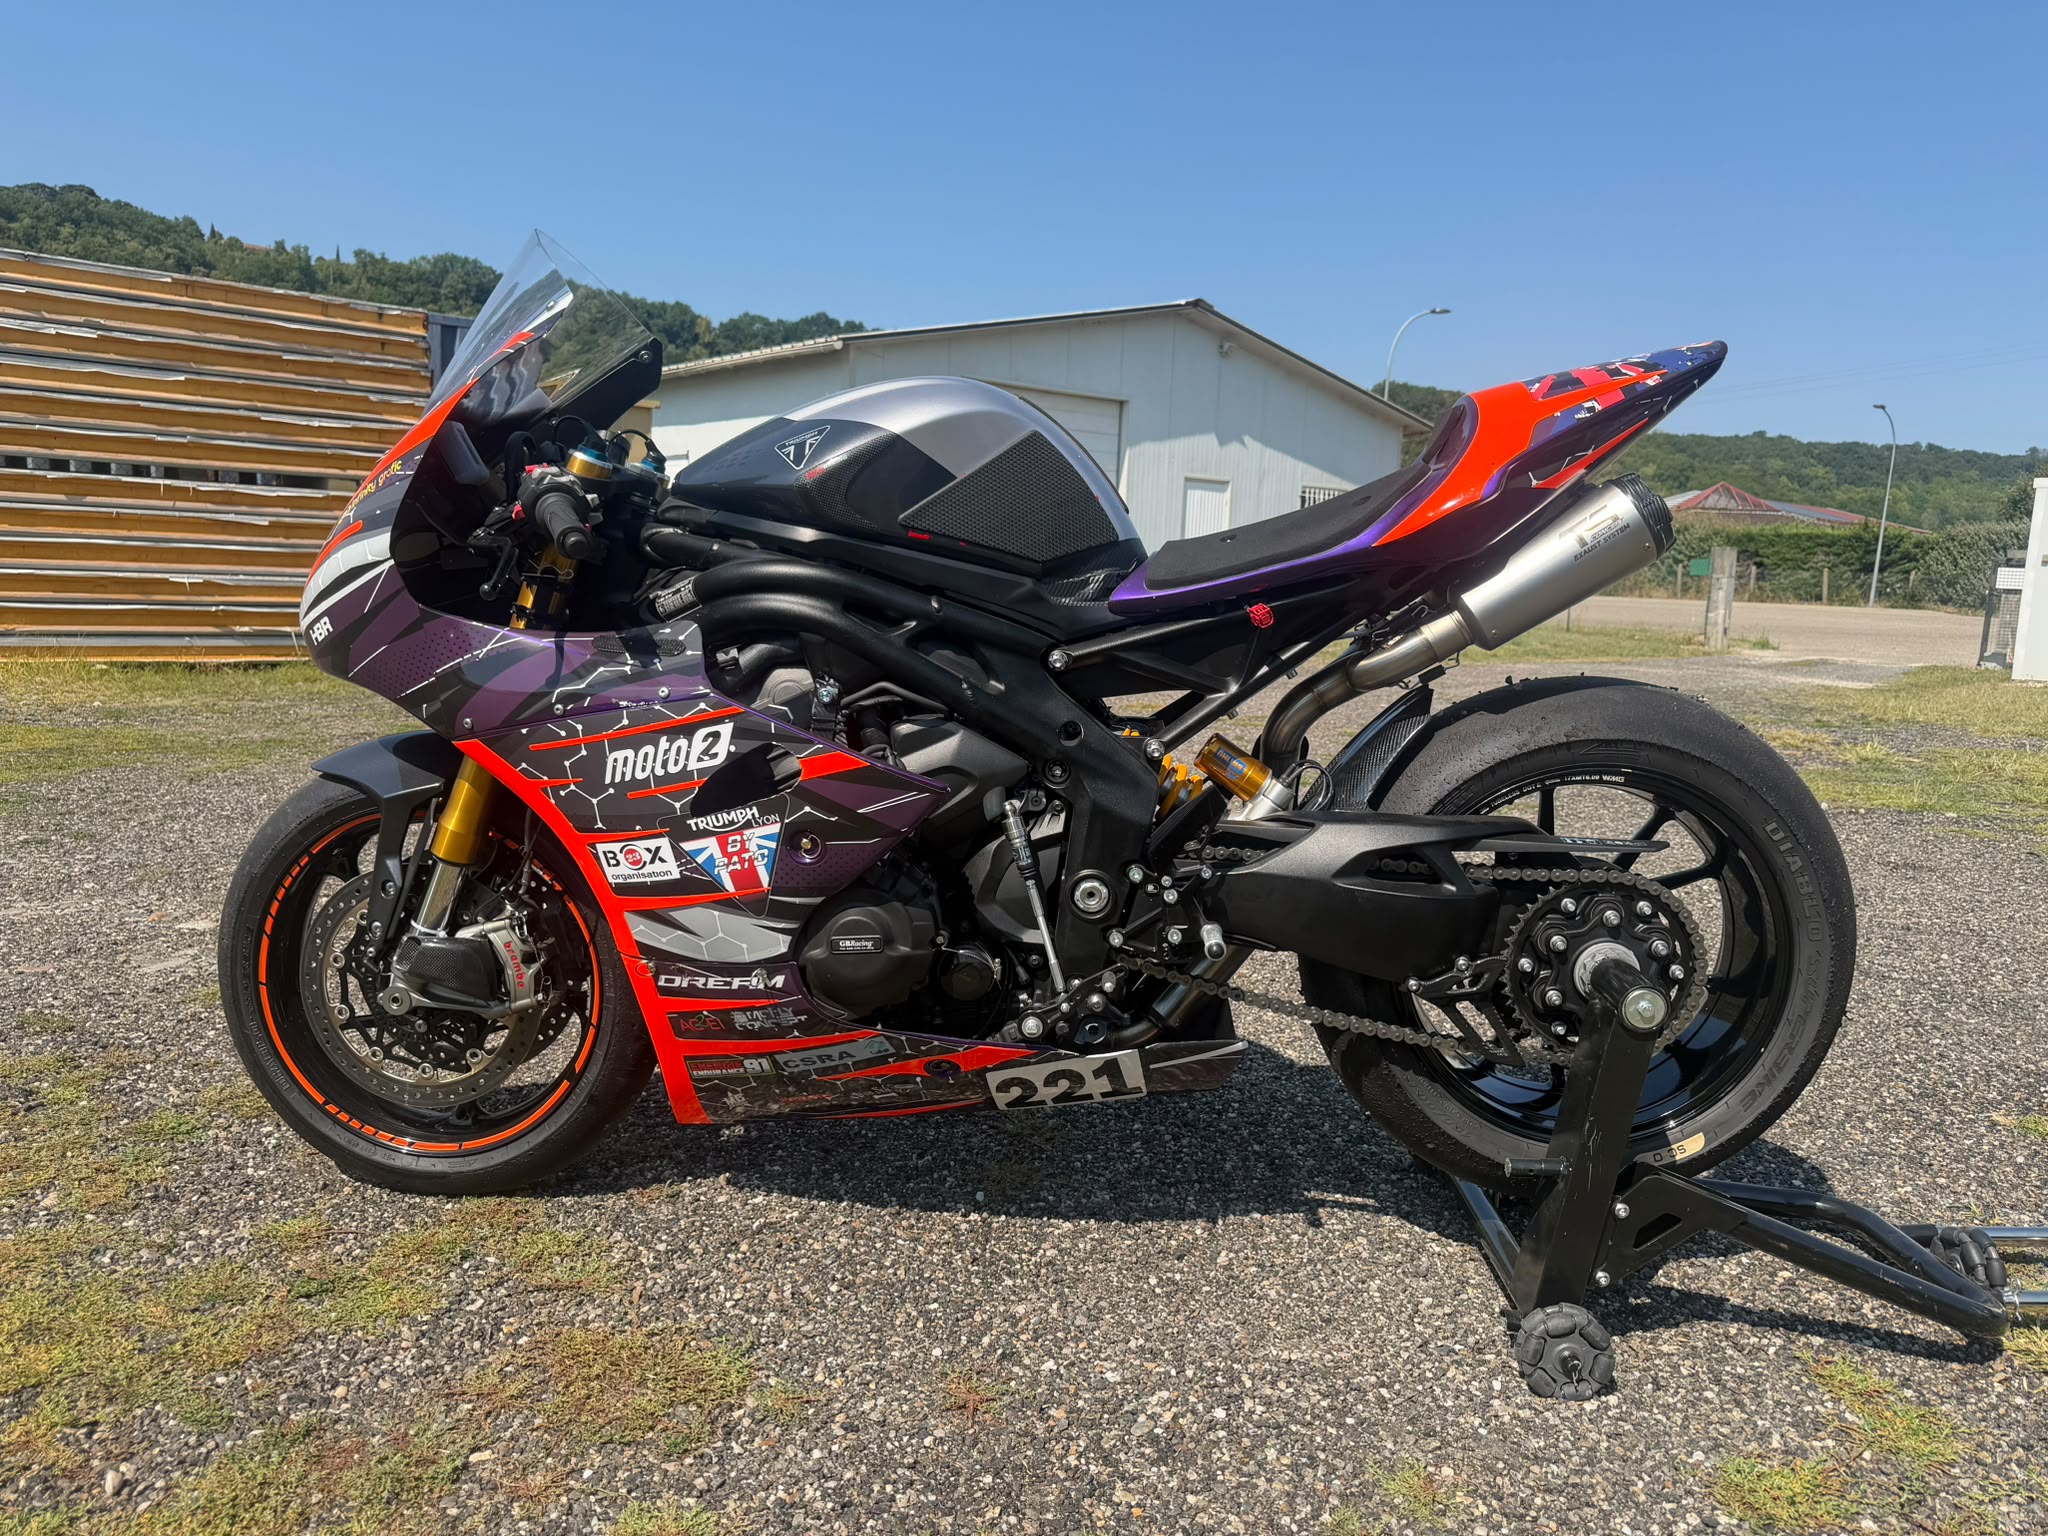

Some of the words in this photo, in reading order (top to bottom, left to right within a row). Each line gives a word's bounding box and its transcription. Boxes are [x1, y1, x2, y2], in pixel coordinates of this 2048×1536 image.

[1573, 540, 1602, 562] EXAUST
[1602, 522, 1631, 544] SYSTEM
[309, 616, 334, 646] HBR
[686, 806, 760, 832] TRIUMPH
[751, 814, 780, 828] LYON
[726, 832, 756, 852] BY
[611, 869, 673, 882] organisation
[1762, 818, 1824, 943] DIABLO
[657, 973, 786, 989] DREAM
[743, 1057, 771, 1074] 91
[781, 1050, 856, 1070] CSRA
[995, 1057, 1144, 1109] 221
